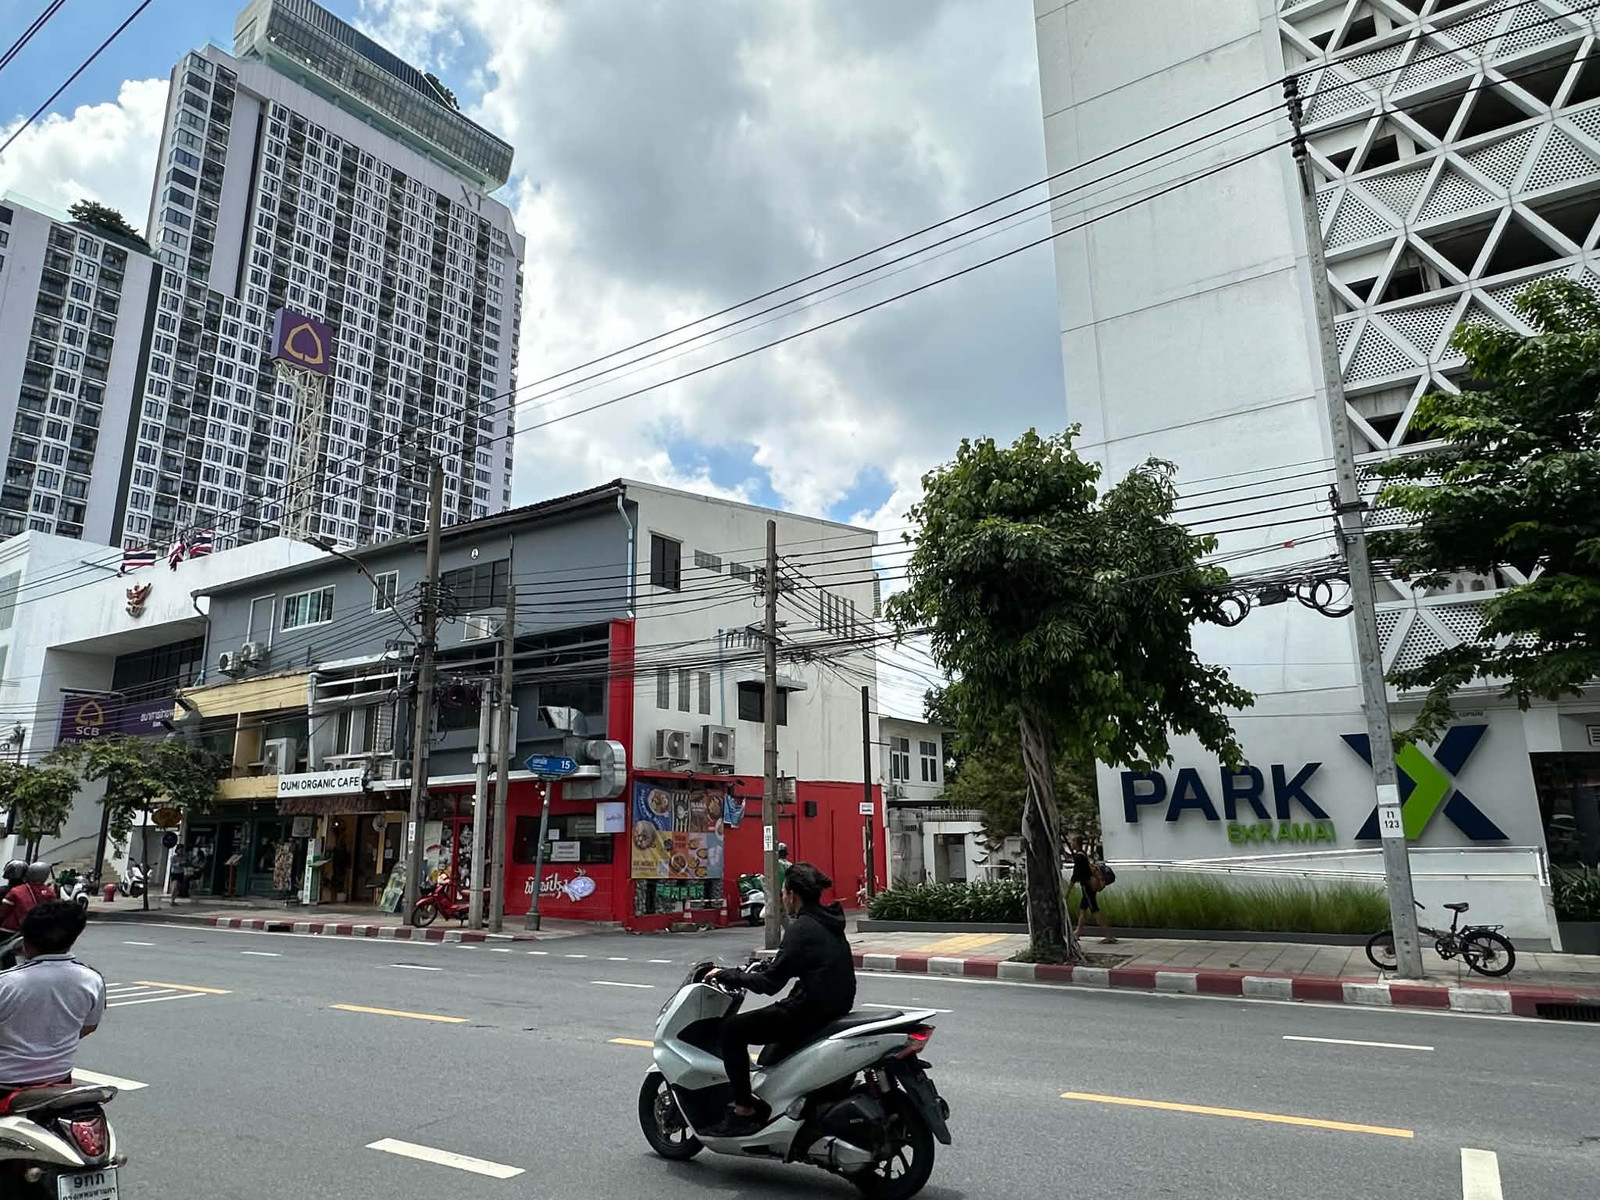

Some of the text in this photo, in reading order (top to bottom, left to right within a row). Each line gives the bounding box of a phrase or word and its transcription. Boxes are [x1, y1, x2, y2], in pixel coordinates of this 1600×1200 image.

[75, 726, 100, 736] SCB
[561, 760, 571, 769] 15
[280, 776, 360, 791] OUMI ORGANIC CAFE
[1120, 762, 1331, 823] PARK
[1384, 820, 1400, 829] 123
[1227, 820, 1337, 844] EKKAMAI
